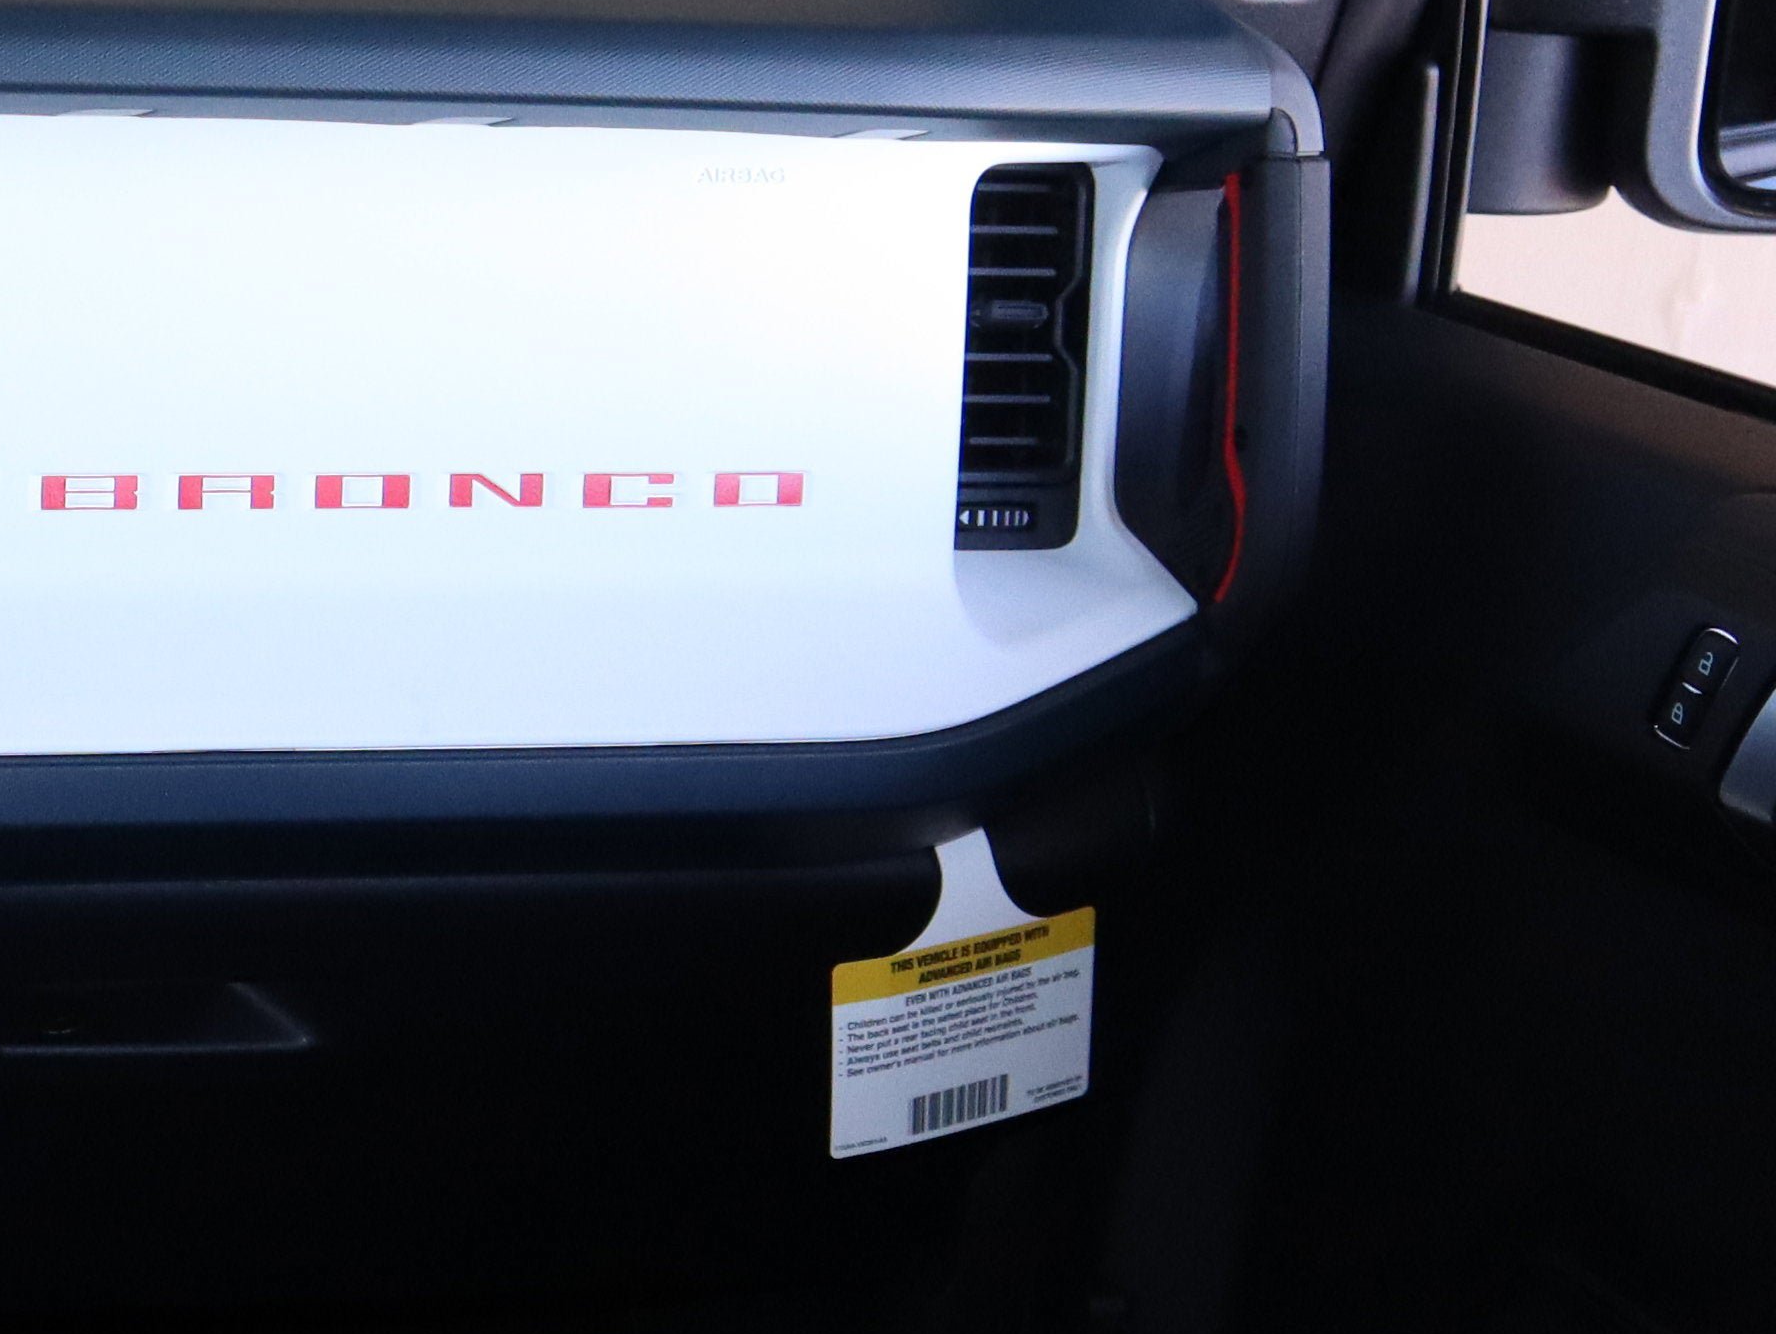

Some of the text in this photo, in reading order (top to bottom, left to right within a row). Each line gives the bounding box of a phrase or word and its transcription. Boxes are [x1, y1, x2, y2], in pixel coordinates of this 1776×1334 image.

[38, 471, 806, 511] BRONCO
[891, 925, 1050, 974] THIS VEHICLE IS EQUIPPED WITH
[919, 950, 1021, 984] ADVANCED AIR BAGS
[905, 968, 1032, 1005] EVEN WITH ADVANCED AIR BAGS
[847, 1015, 887, 1032] Children
[920, 1002, 942, 1014] killed
[847, 1018, 969, 1055] Never put facing child
[848, 1003, 986, 1043] The back seat safest place
[847, 1027, 982, 1068] Always seat belts and child
[847, 1022, 1046, 1078] See owner's manual more information about
